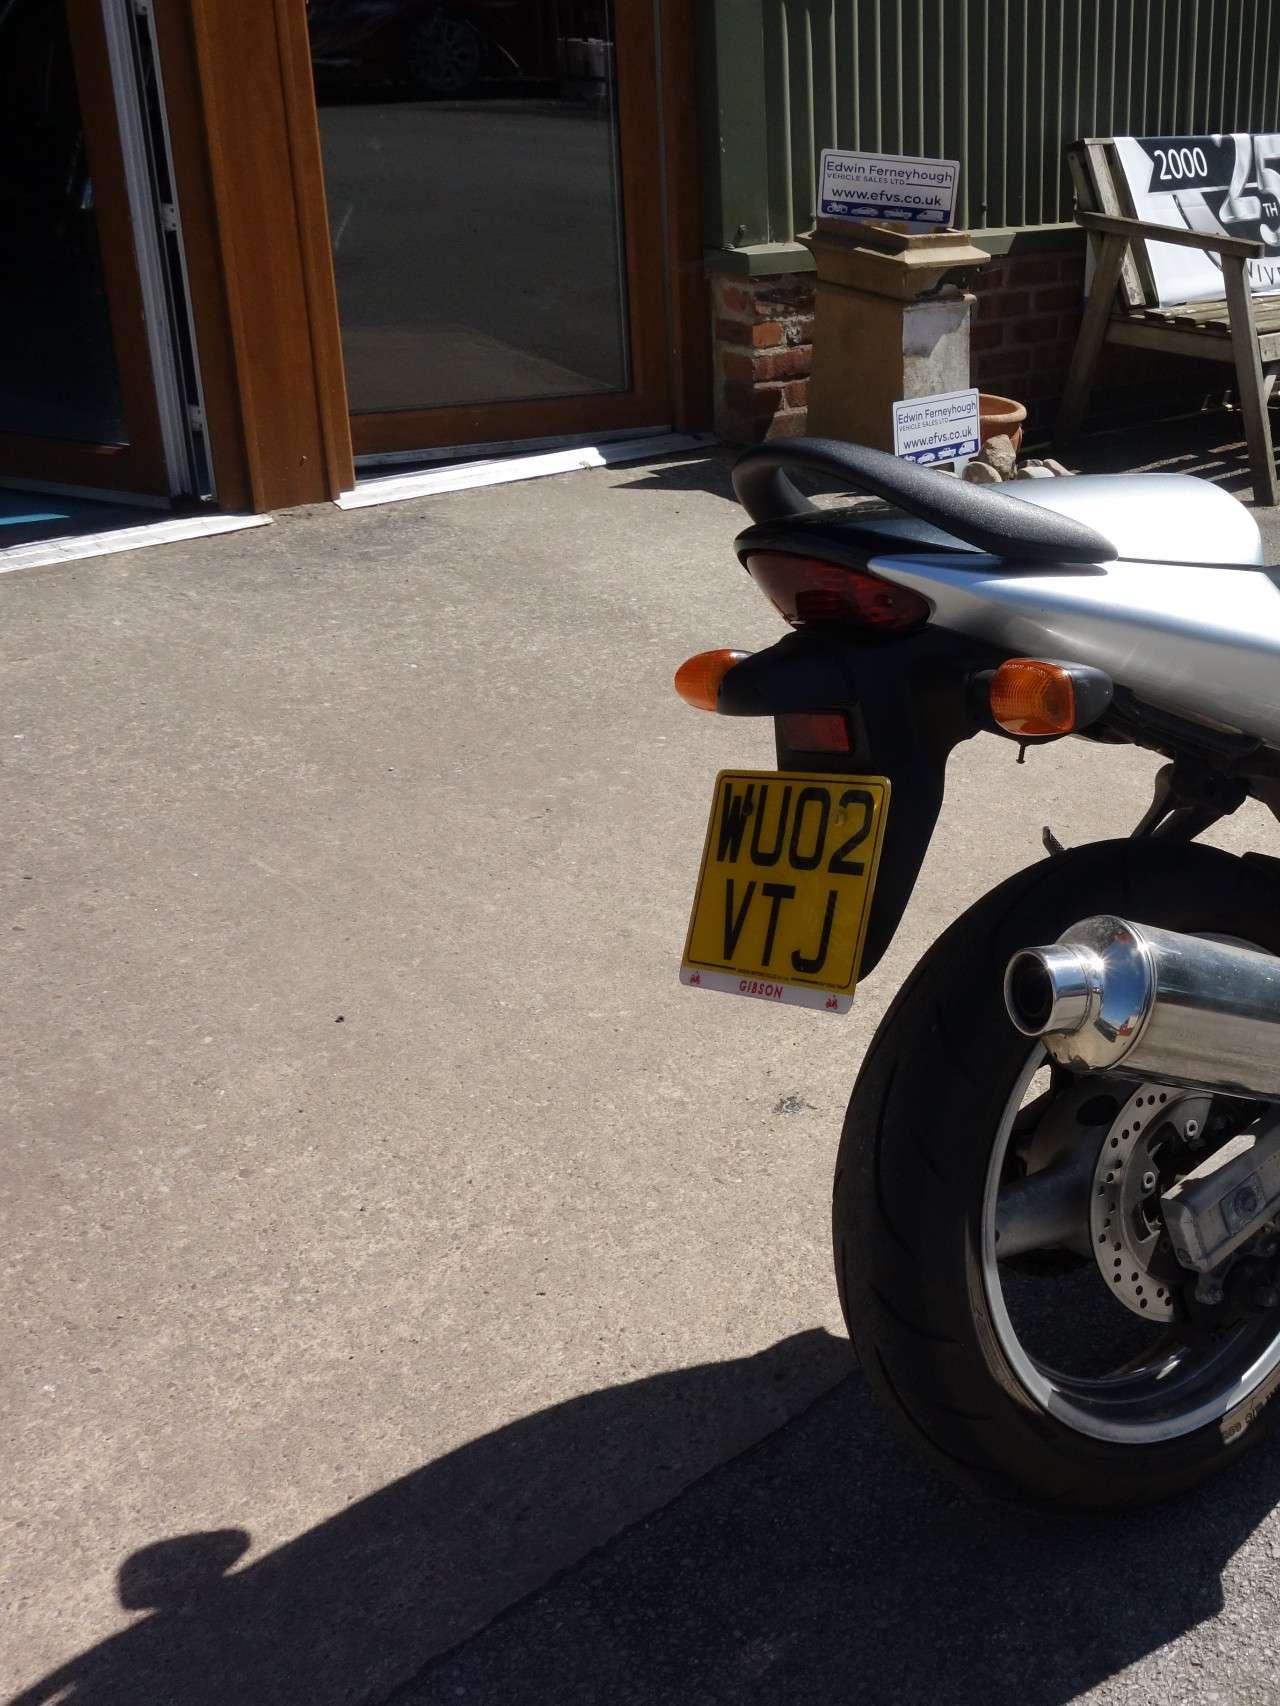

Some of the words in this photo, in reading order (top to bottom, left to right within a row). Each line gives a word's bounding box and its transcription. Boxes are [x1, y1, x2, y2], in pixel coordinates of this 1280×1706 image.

[827, 161, 866, 174] Edwin
[869, 165, 953, 184] Ferneyhough
[1154, 147, 1208, 181] 2000
[827, 173, 861, 182] VEHICLE
[832, 187, 942, 206] www.efvs.co.uk
[1262, 202, 1279, 218] TH
[898, 412, 924, 424] Edwin
[924, 401, 976, 418] Ferneyhough
[898, 424, 921, 432] VEHICLE
[922, 420, 939, 428] SALES
[939, 417, 949, 425] LTD
[904, 426, 972, 449] www.efvs.co.uk
[716, 782, 875, 876] WU02
[723, 878, 838, 974] VTJ
[739, 979, 783, 998] GIBSON
